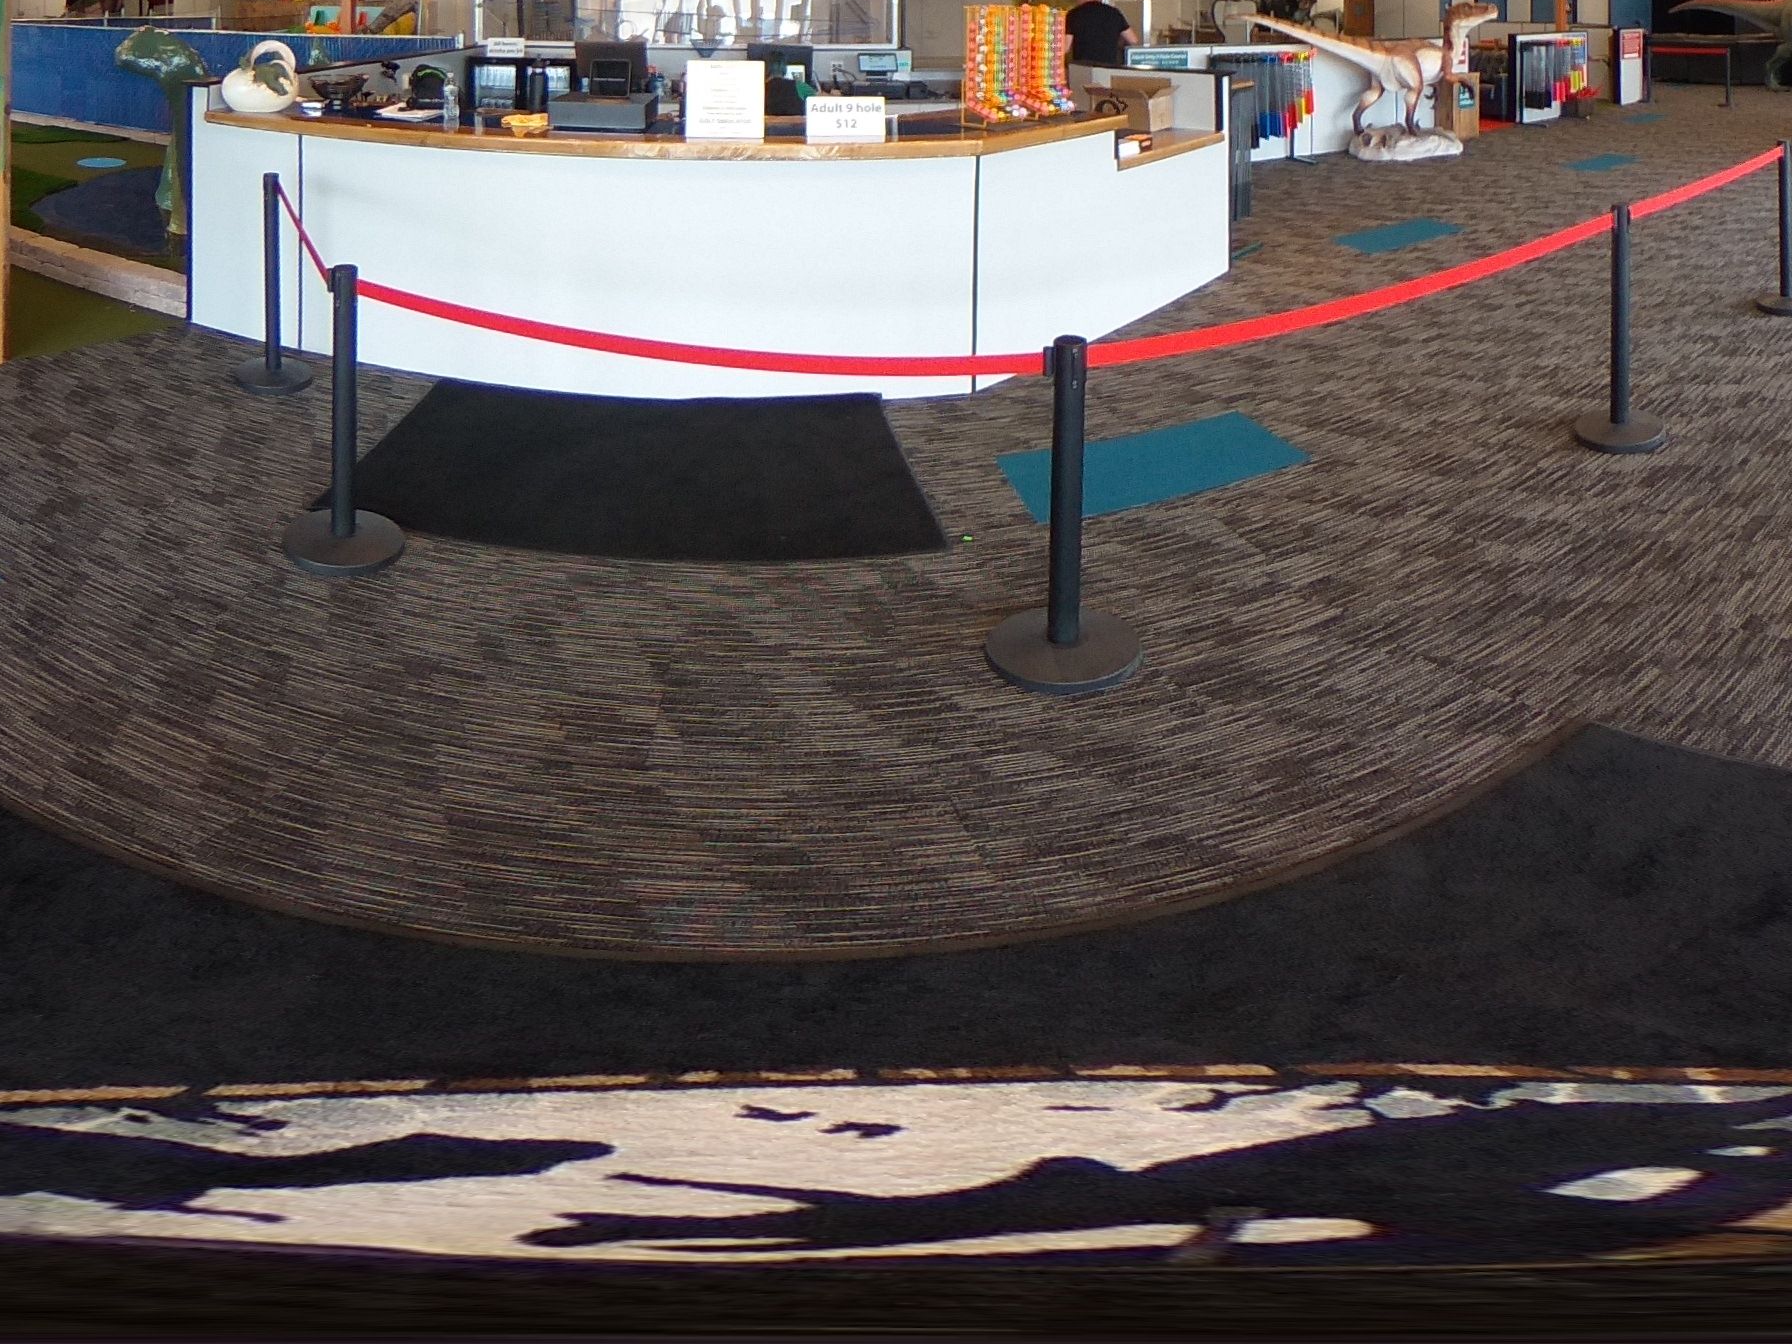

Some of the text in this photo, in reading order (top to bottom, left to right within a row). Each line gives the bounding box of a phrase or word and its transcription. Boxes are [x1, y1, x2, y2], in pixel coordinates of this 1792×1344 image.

[810, 103, 882, 113] Adult 9 hole
